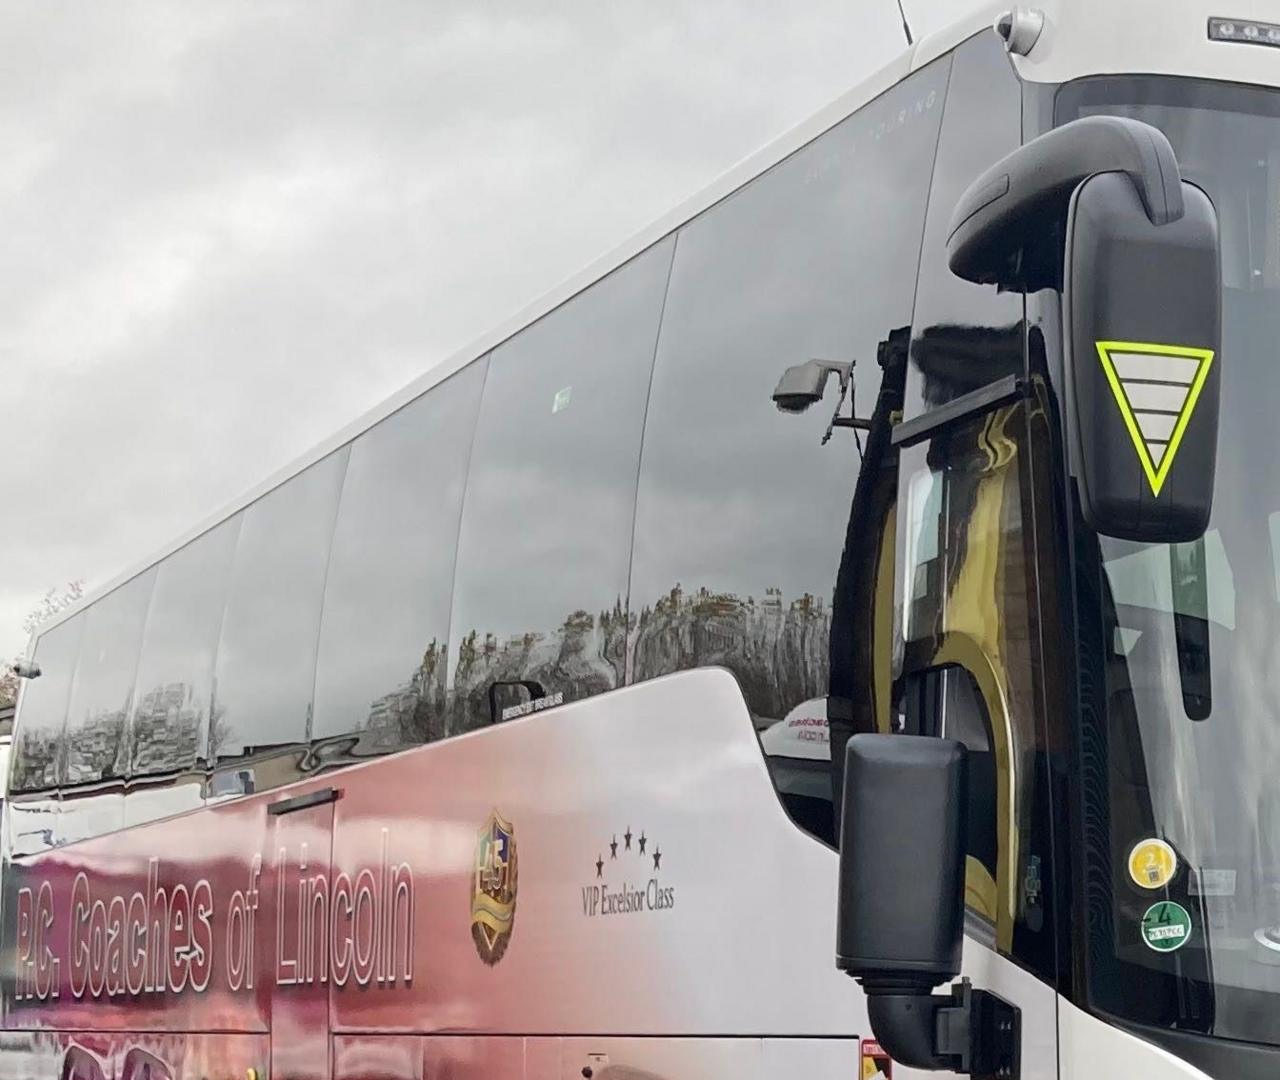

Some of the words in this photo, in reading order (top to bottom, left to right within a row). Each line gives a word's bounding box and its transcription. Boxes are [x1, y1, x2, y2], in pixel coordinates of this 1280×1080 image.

[68, 857, 214, 998] Coaches
[226, 852, 262, 991] of
[276, 827, 415, 986] Lincoln
[582, 886, 600, 917] VIP
[601, 882, 645, 915] Excelsior
[646, 878, 674, 911] Class
